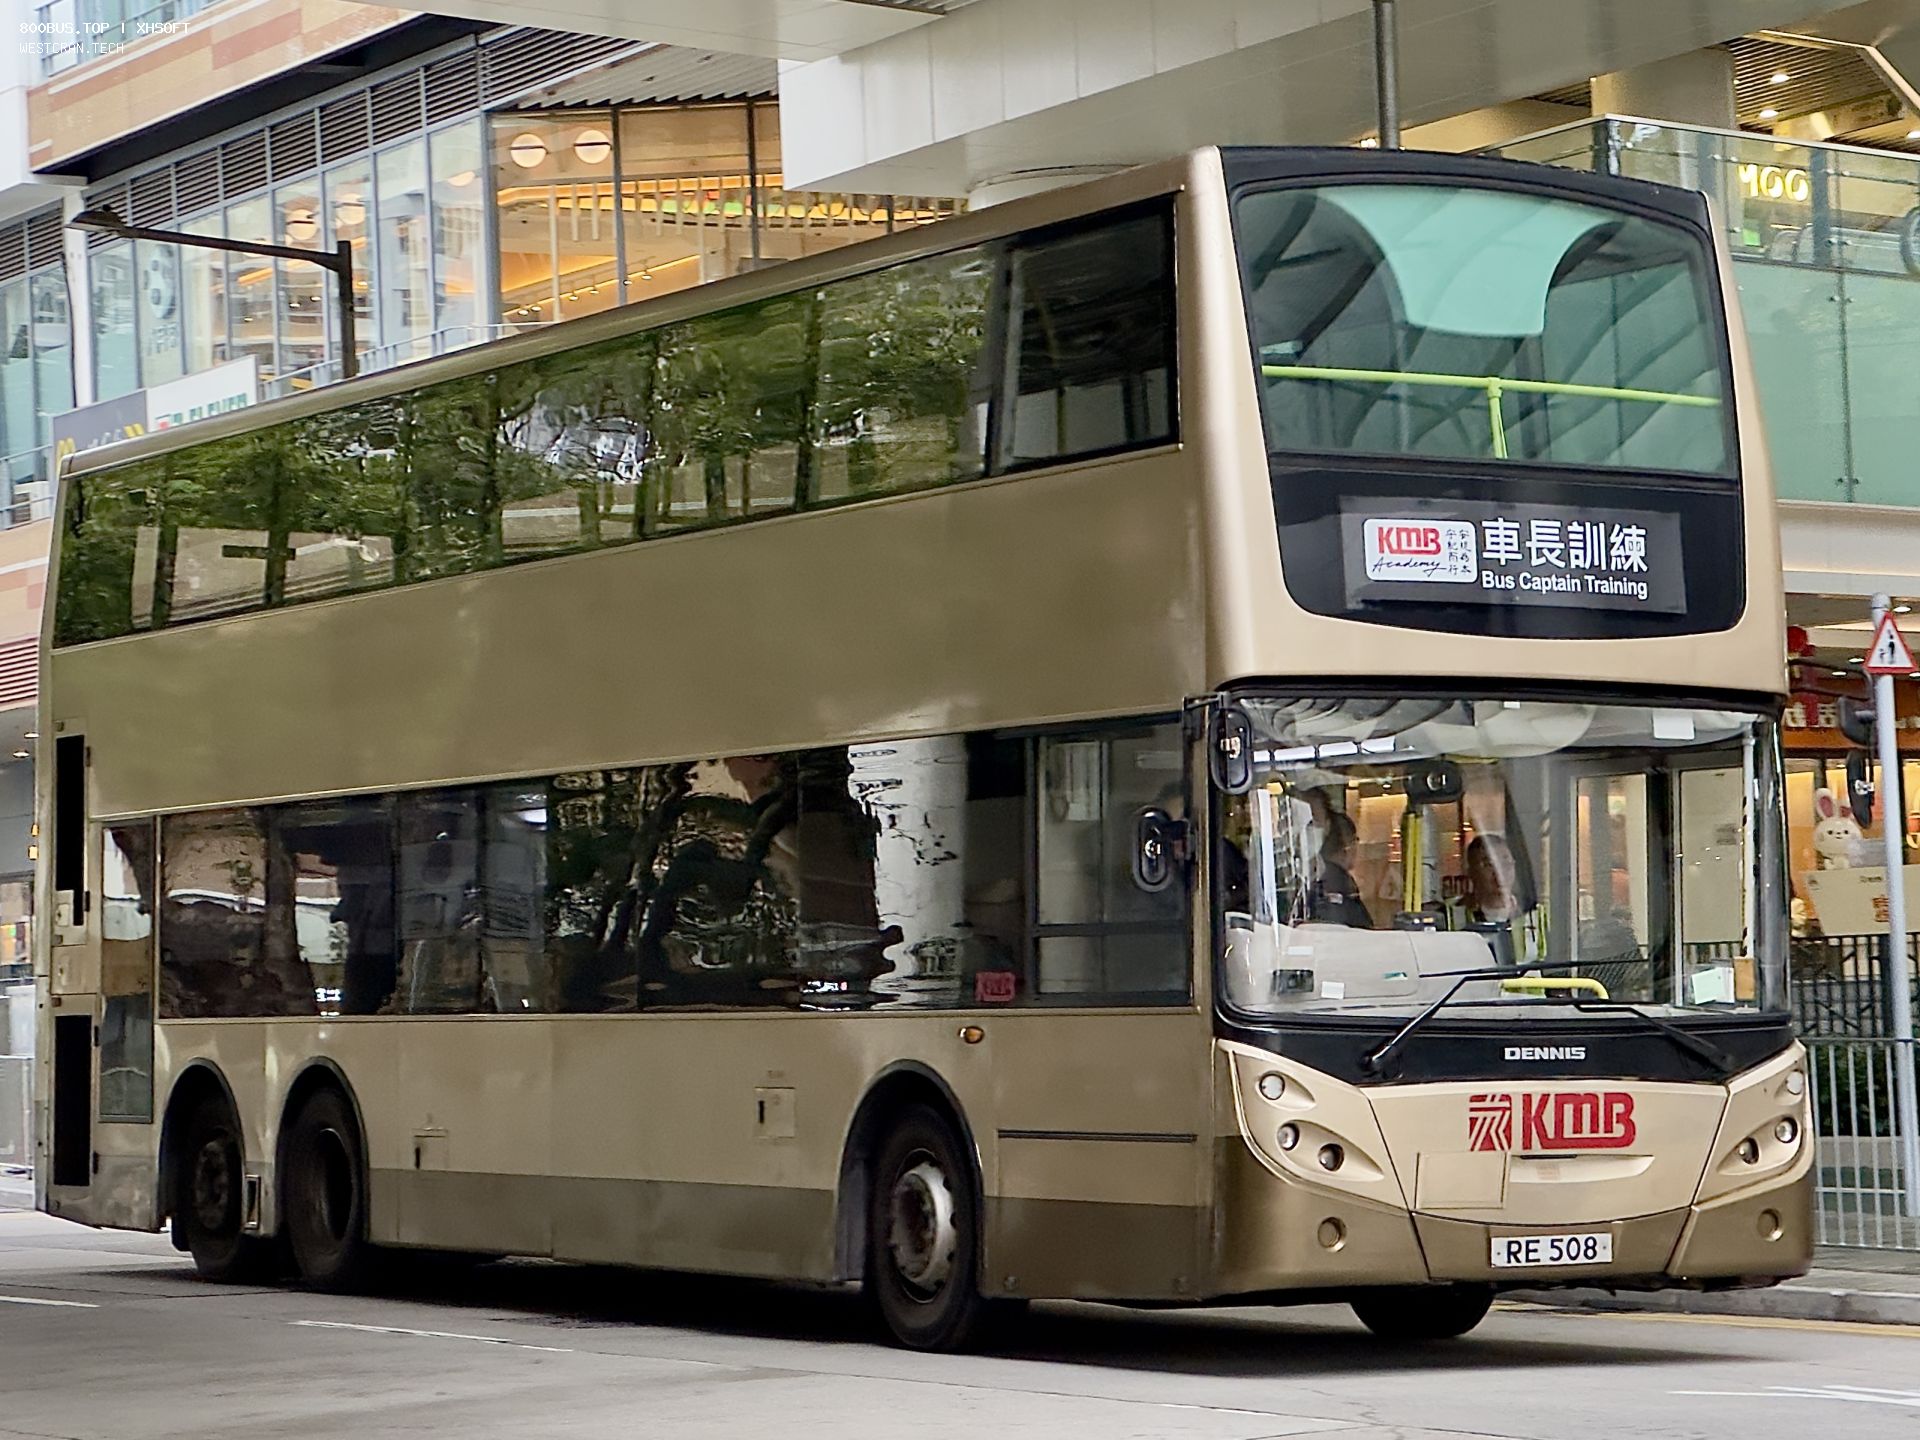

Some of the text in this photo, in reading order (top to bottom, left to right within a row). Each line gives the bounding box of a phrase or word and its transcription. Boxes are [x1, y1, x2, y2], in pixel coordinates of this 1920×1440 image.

[1377, 527, 1441, 555] KMB
[1481, 517, 1648, 573] 車長訓練
[1372, 556, 1447, 577] Academy
[1481, 570, 1648, 600] Bus Captain Training
[1504, 1046, 1586, 1060] DENNIS
[1522, 1092, 1636, 1150] KMB
[1506, 1236, 1598, 1264] RE 508
